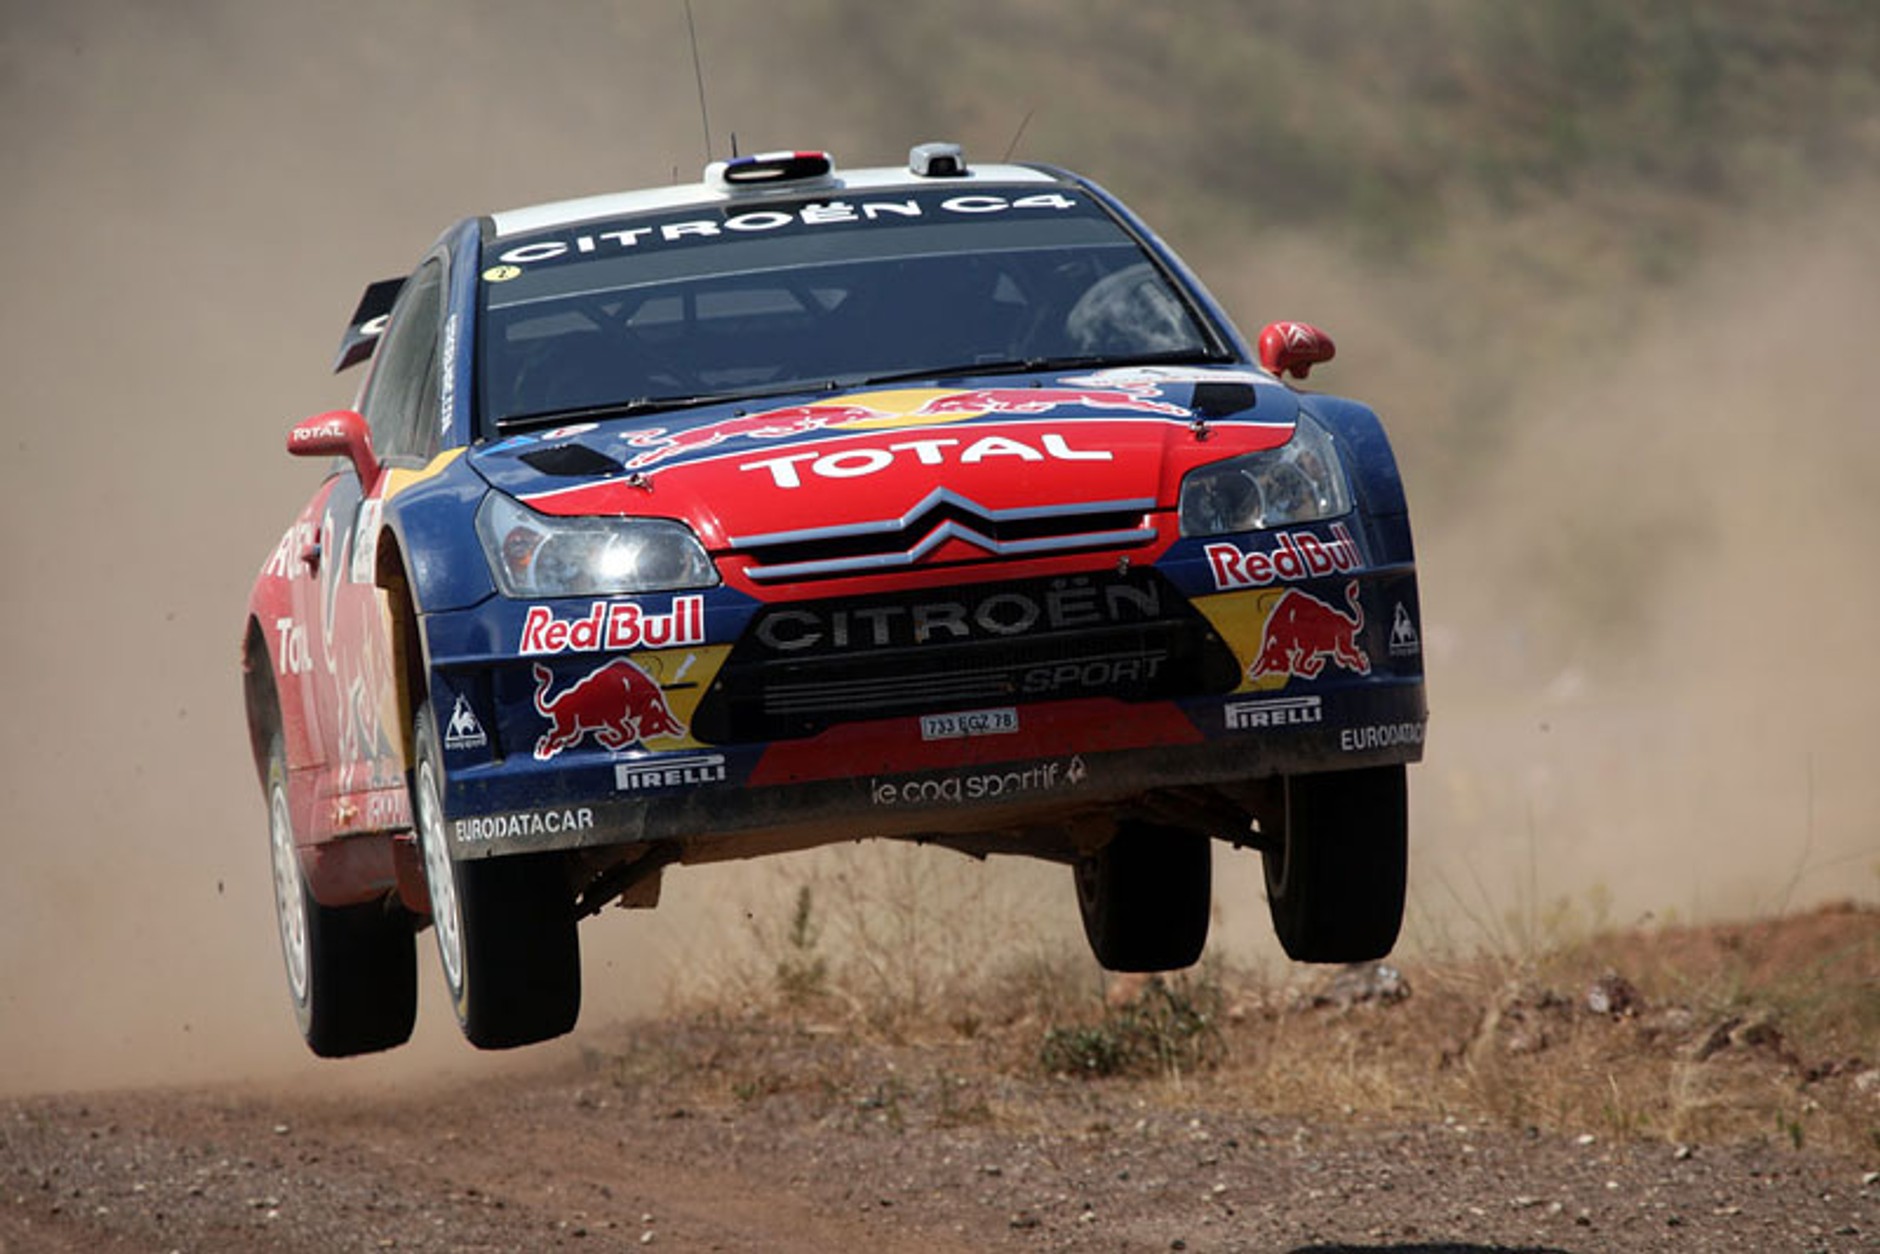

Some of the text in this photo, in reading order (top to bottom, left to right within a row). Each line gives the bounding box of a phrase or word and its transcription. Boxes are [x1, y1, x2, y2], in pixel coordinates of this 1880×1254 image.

[499, 194, 1077, 263] CITROËN C4
[292, 420, 345, 442] TOTAL
[739, 433, 1114, 489] TOTAL
[755, 576, 1161, 650] CITROËN
[1022, 654, 1167, 694] SPORT
[928, 719, 955, 735] 733
[994, 712, 1012, 729] 78
[1225, 696, 1322, 729] PIRELLI
[615, 754, 726, 791] PIRELLI
[871, 761, 1060, 805] le coq sportif
[455, 807, 594, 843] EURODATACAR
